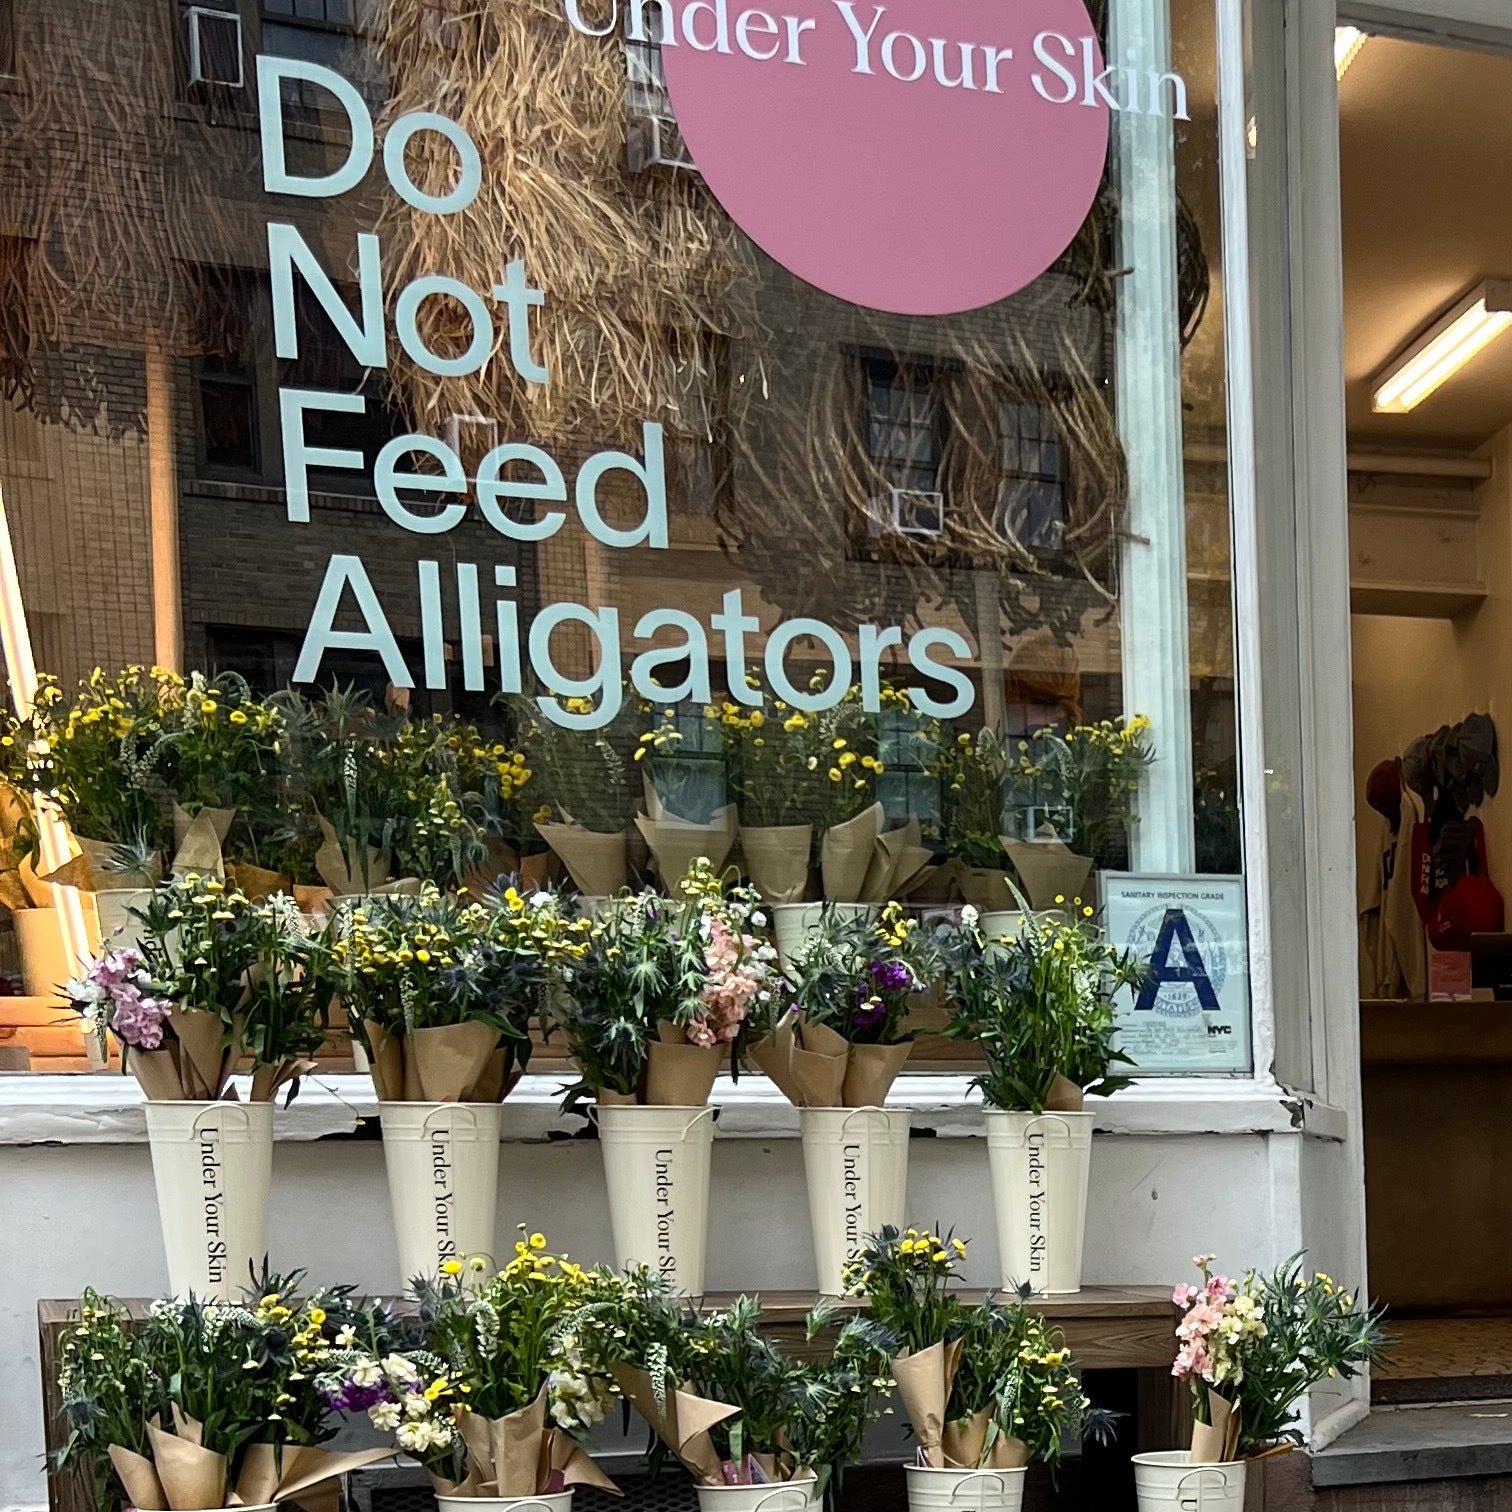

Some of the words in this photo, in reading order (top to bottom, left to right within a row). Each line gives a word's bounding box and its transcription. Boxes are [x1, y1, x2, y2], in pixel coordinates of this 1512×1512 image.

[834, 0, 1013, 94] Your
[1031, 31, 1192, 121] Skin
[256, 53, 481, 214] Do
[266, 220, 549, 384] Not
[278, 387, 669, 549] Feed
[291, 554, 976, 731] Alligators
[1134, 908, 1221, 1011] A
[1207, 1025, 1232, 1035] NYC
[199, 1127, 221, 1189] Under
[431, 1128, 452, 1189] Under
[655, 1149, 674, 1207] Under
[843, 1143, 861, 1201] Under
[1028, 1133, 1045, 1186] Under
[204, 1192, 224, 1236] Your
[434, 1192, 454, 1237] Your
[656, 1209, 675, 1253] Your
[845, 1203, 862, 1246] Your
[1029, 1189, 1047, 1231] Your
[206, 1241, 227, 1284] Skin
[437, 1239, 456, 1281] Skn
[1029, 1233, 1047, 1273] Skin
